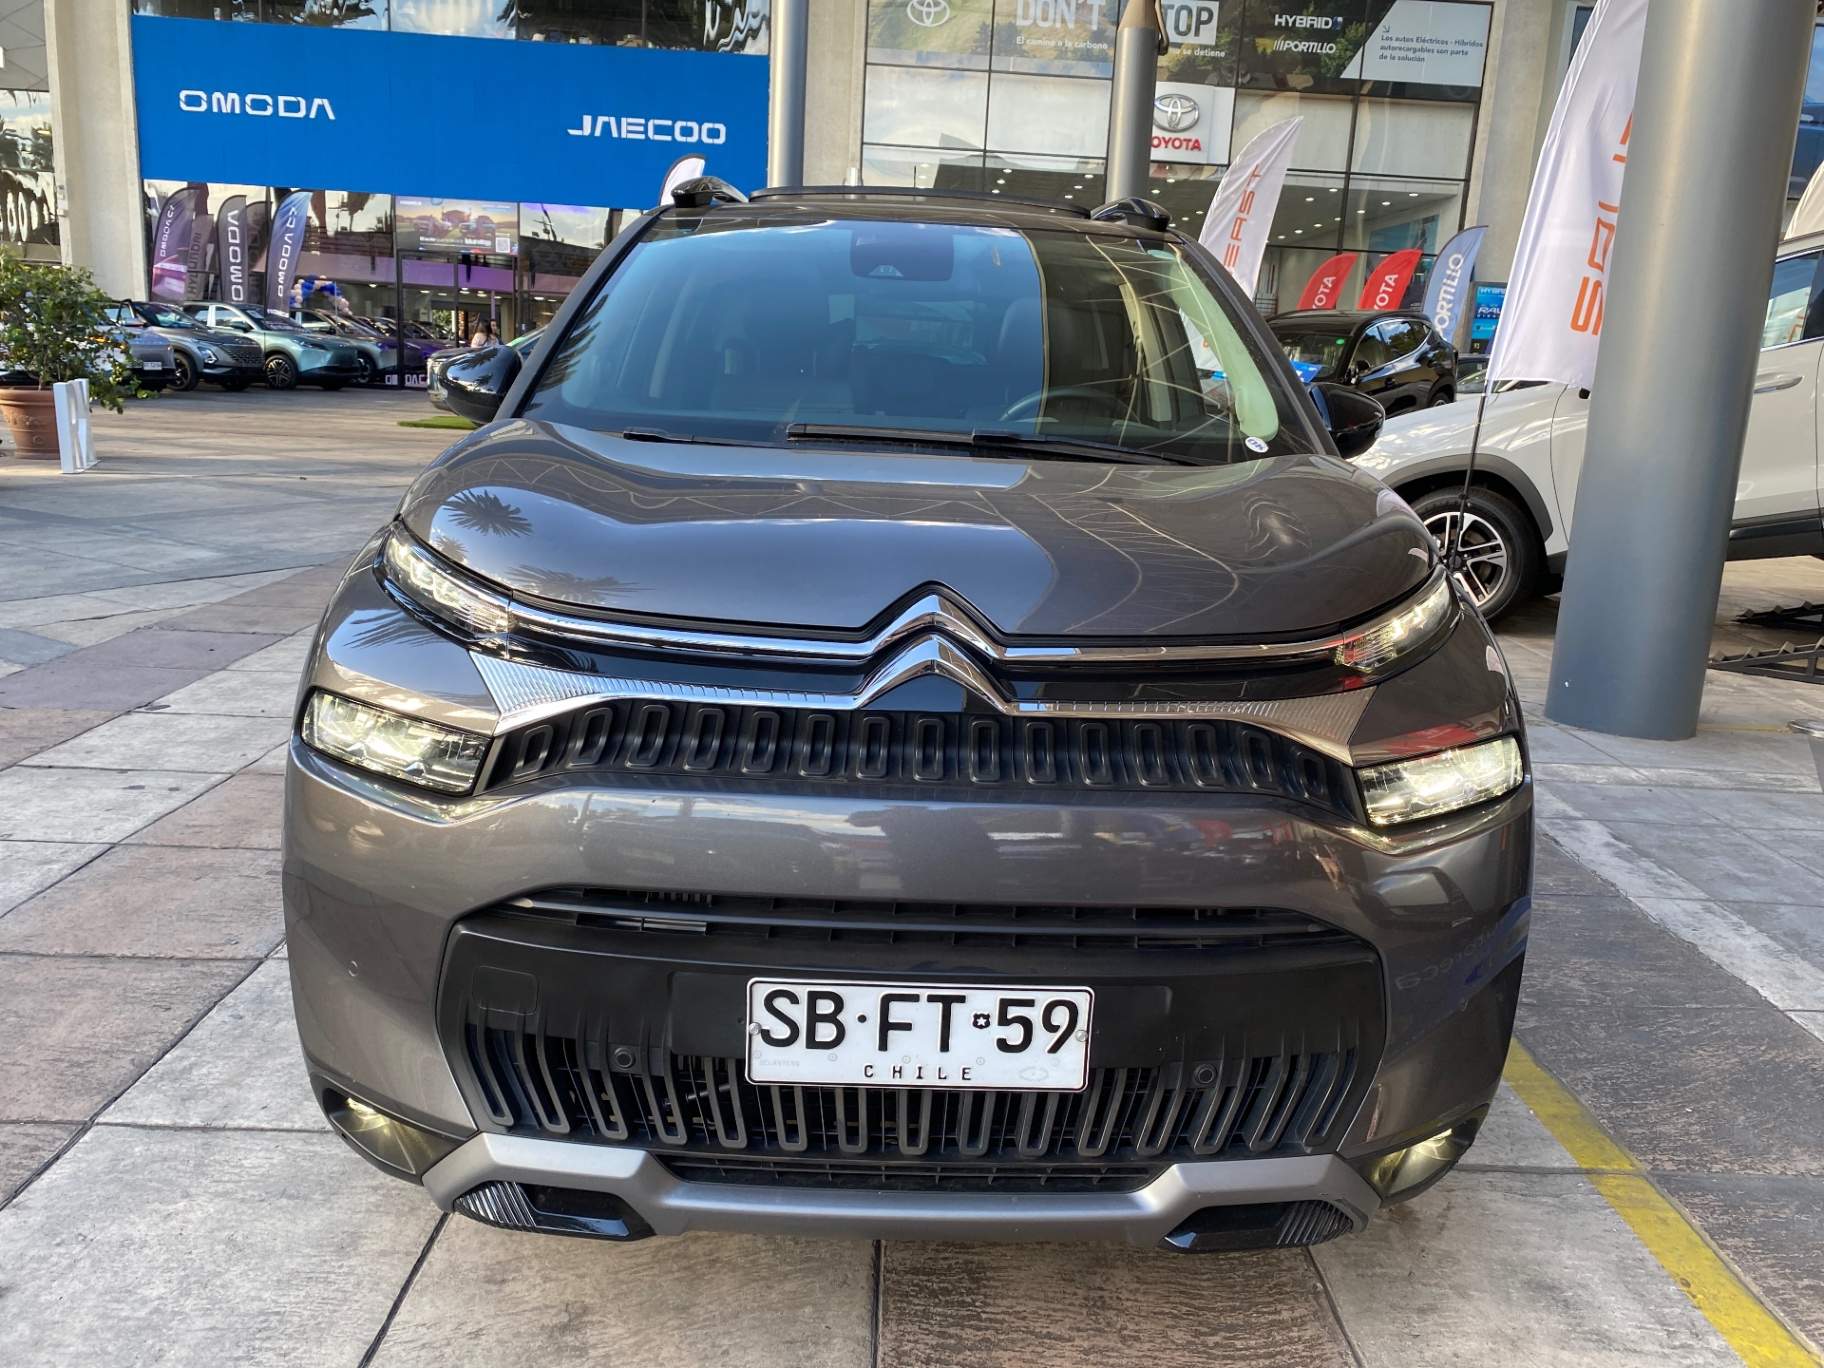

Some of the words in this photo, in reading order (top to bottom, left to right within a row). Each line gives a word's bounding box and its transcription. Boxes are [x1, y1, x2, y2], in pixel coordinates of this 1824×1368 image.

[1274, 14, 1333, 29] HYBRID
[1016, 36, 1024, 45] El
[1381, 34, 1394, 42] Los
[1395, 35, 1414, 43] autos
[1194, 47, 1226, 58] detiene
[1283, 40, 1337, 54] PORTILLO
[179, 89, 336, 120] OMODA
[567, 115, 727, 145] JAECOO
[1150, 136, 1202, 151] OYOTA
[227, 209, 244, 301] OMODA
[277, 233, 294, 297] OMODA
[863, 1064, 972, 1081] CHILE
